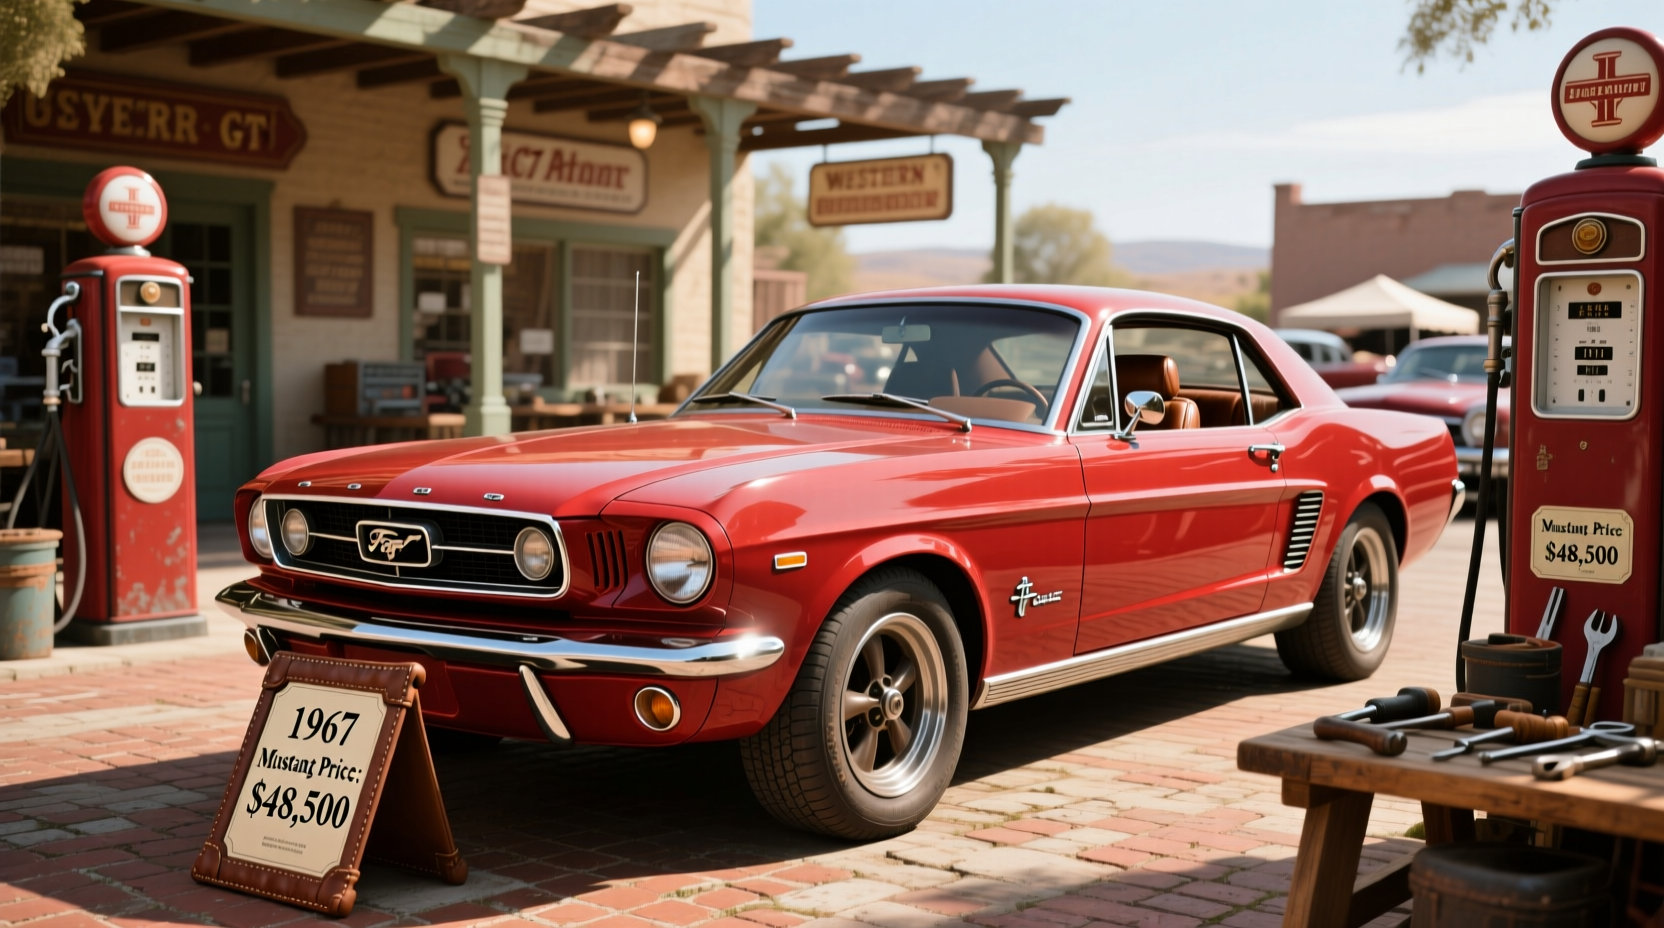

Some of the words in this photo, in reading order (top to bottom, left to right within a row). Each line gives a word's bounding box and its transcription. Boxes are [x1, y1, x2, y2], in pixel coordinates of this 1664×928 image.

[219, 110, 268, 151] GT
[825, 163, 925, 191] WESTERN
[1545, 540, 1619, 567] $48,500
[287, 706, 360, 746] 1967
[256, 747, 316, 779] Mustang
[318, 756, 362, 784] Price:
[246, 778, 350, 829] $48,500
